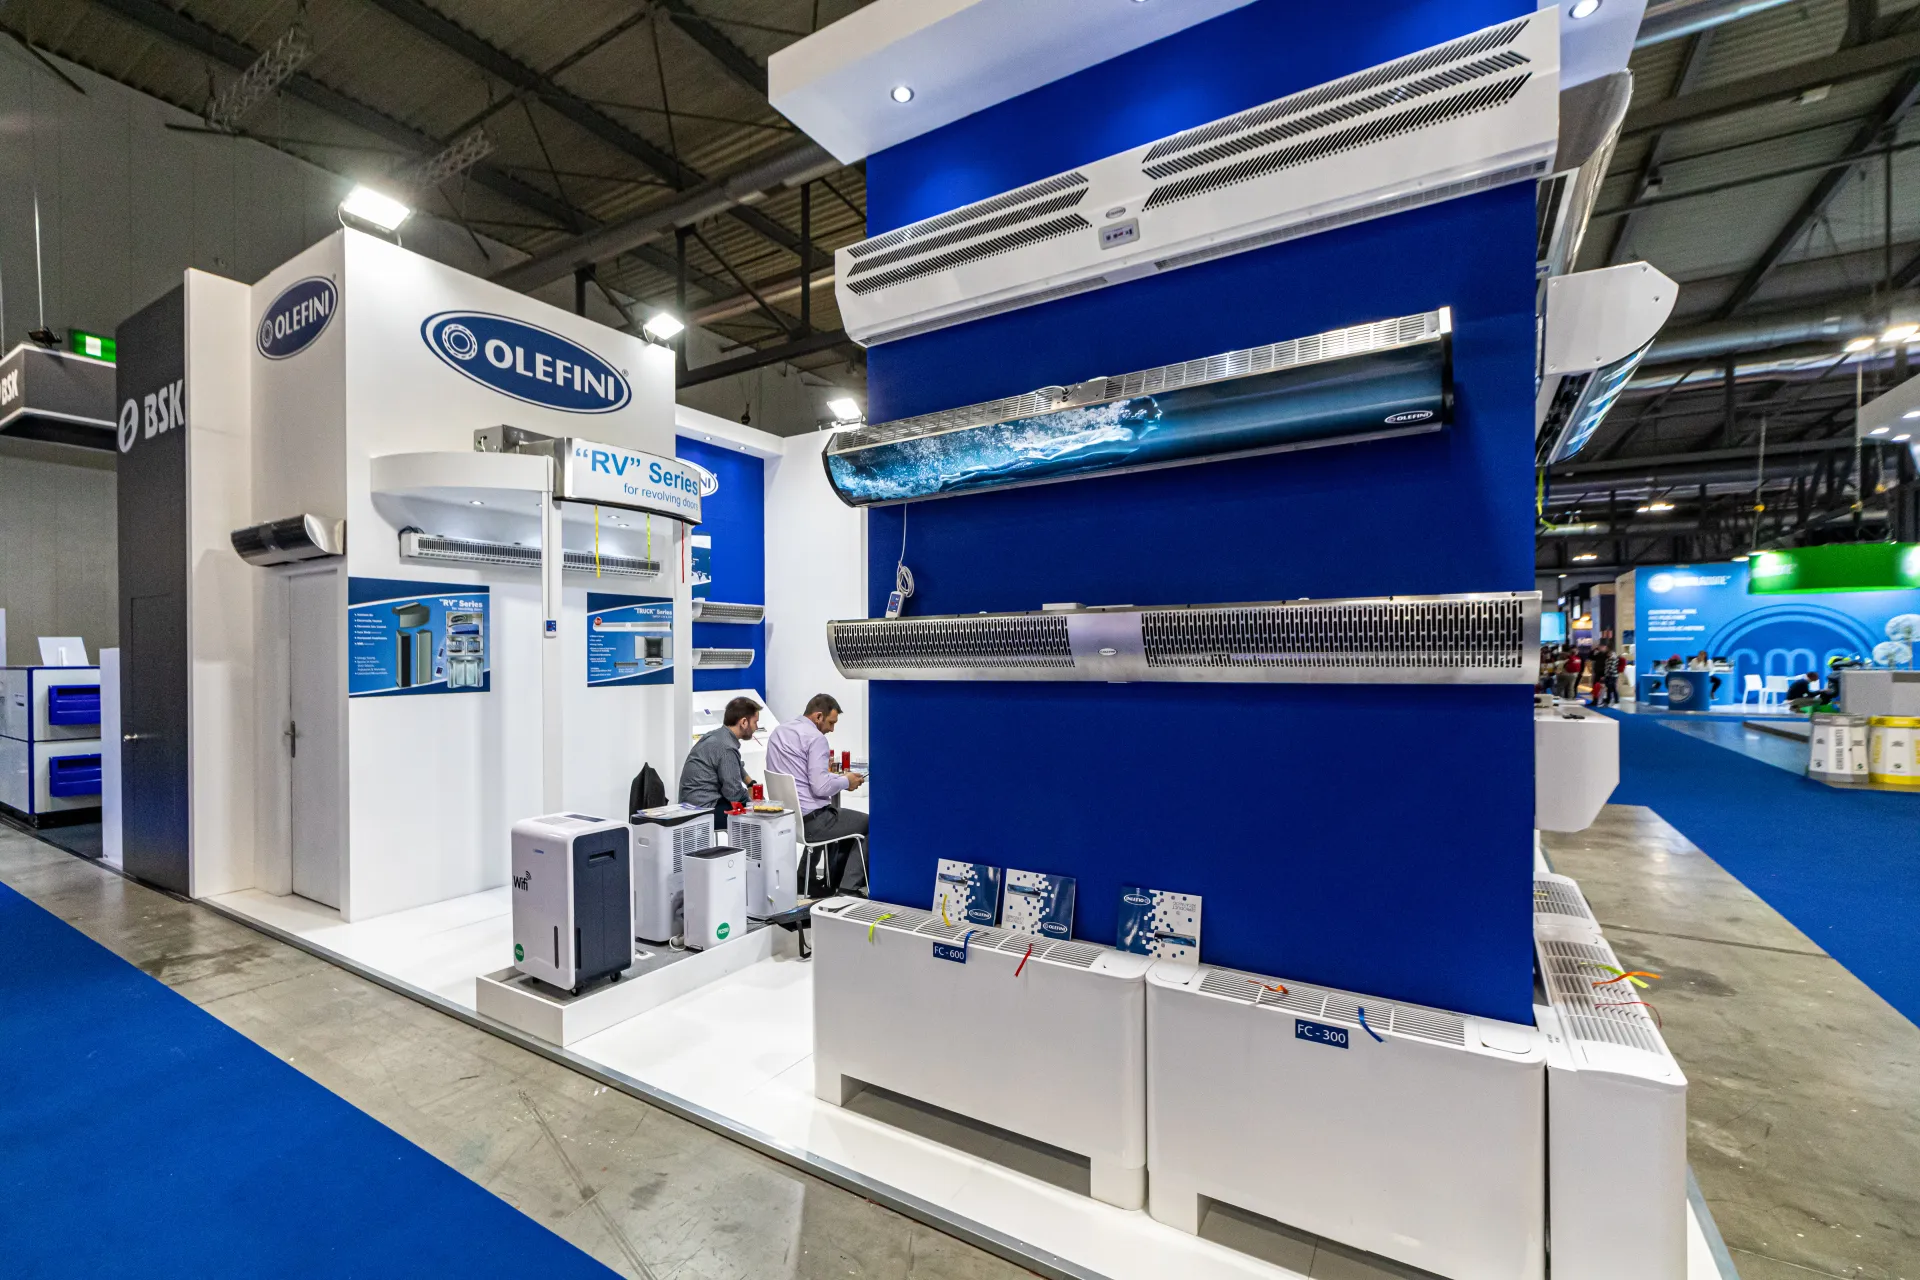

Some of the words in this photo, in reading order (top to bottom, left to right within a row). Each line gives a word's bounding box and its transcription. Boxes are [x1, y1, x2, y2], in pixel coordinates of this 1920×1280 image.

[274, 289, 330, 341] OLEFINI
[484, 338, 616, 403] OLEFINI
[0, 368, 19, 406] BSK
[144, 378, 185, 440] BSK
[648, 462, 698, 496] Series
[623, 482, 639, 495] for
[641, 487, 681, 508] revolving
[682, 497, 699, 511] doors
[459, 599, 483, 608] Series
[656, 608, 673, 616] Series
[513, 875, 529, 892] Wifi
[934, 945, 945, 956] FC
[949, 949, 965, 960] 600
[1297, 1023, 1313, 1037] FC
[1322, 1029, 1346, 1044] 300
